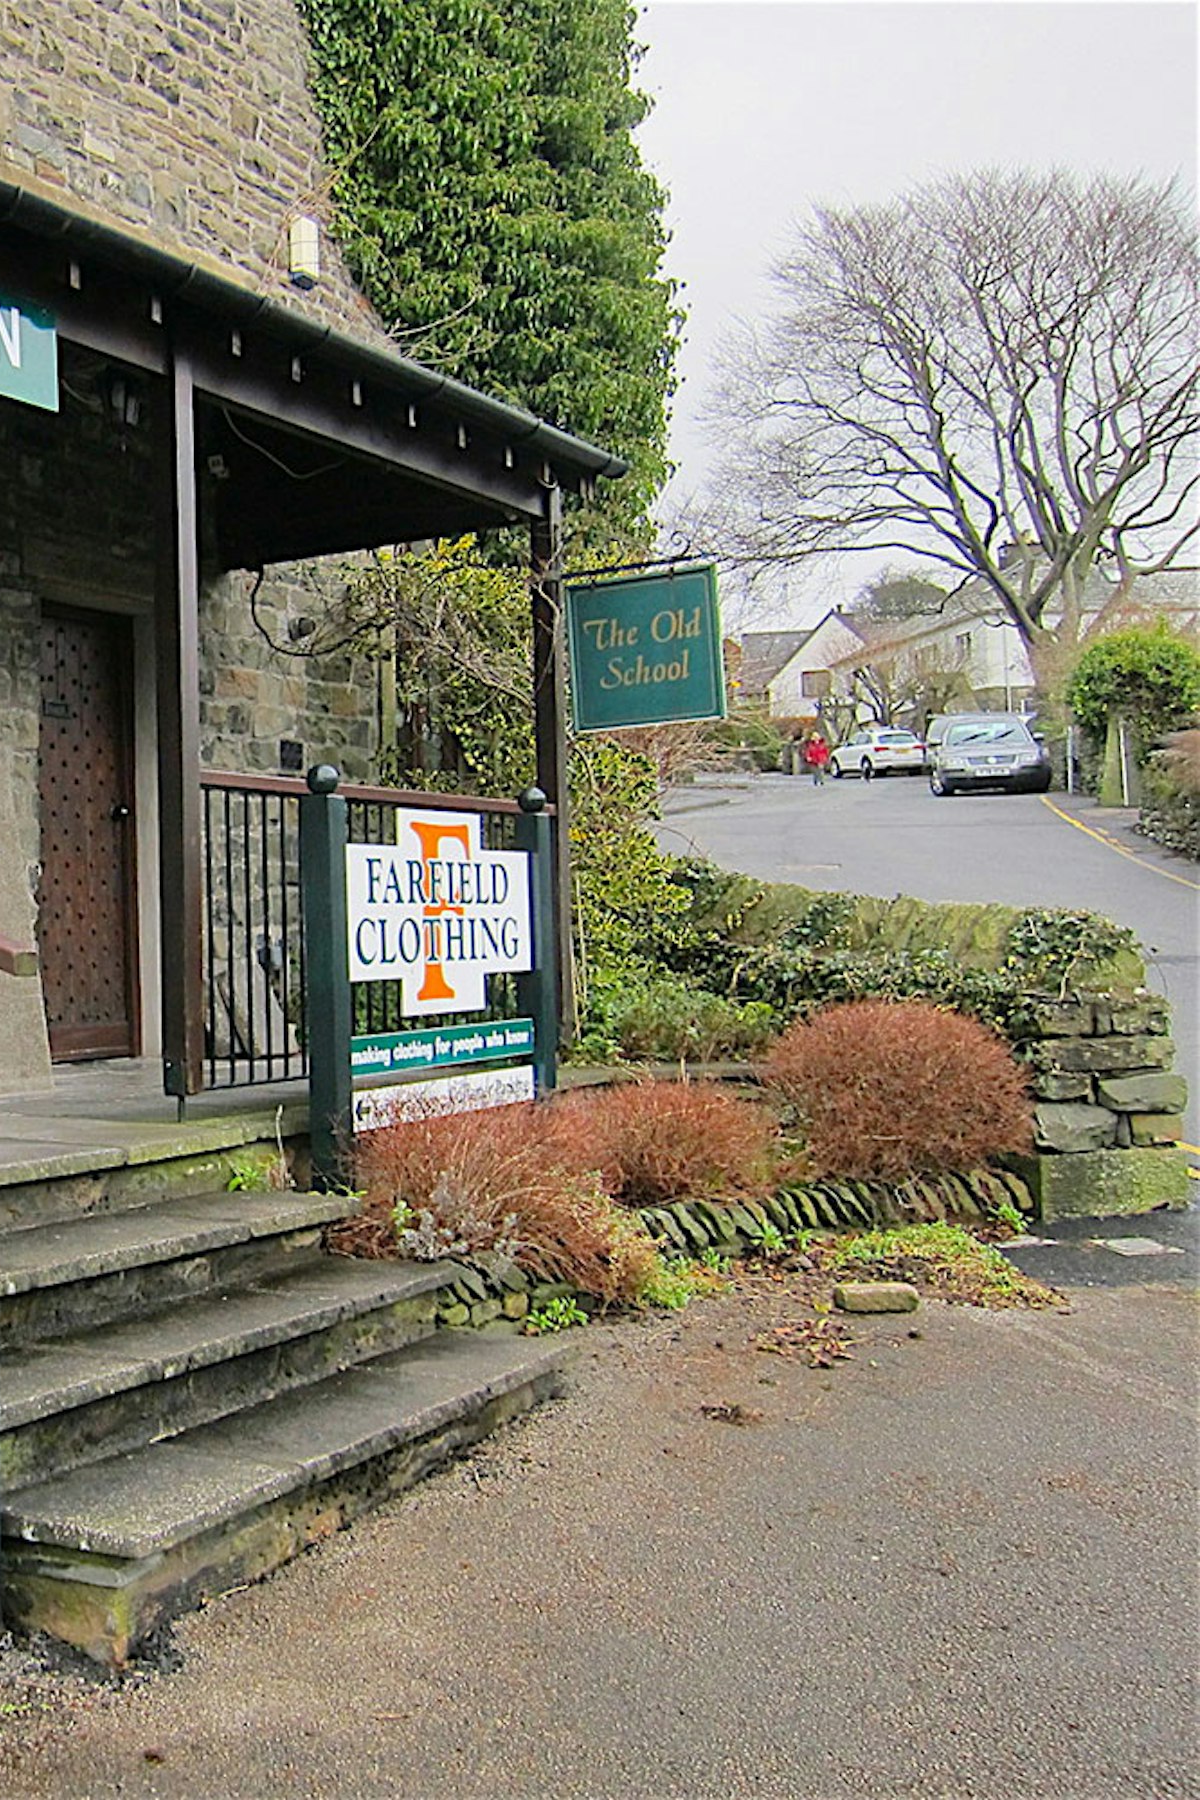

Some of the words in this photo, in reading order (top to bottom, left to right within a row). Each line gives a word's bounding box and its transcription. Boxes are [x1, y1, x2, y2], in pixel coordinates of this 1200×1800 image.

[583, 618, 639, 650] The
[650, 606, 702, 643] Old
[600, 649, 690, 689] School
[366, 858, 509, 905] FARFIELD
[356, 916, 519, 966] CLOTHING
[351, 1045, 391, 1067] making
[393, 1038, 433, 1062] clothing
[435, 1035, 452, 1055] for
[452, 1032, 485, 1057] people
